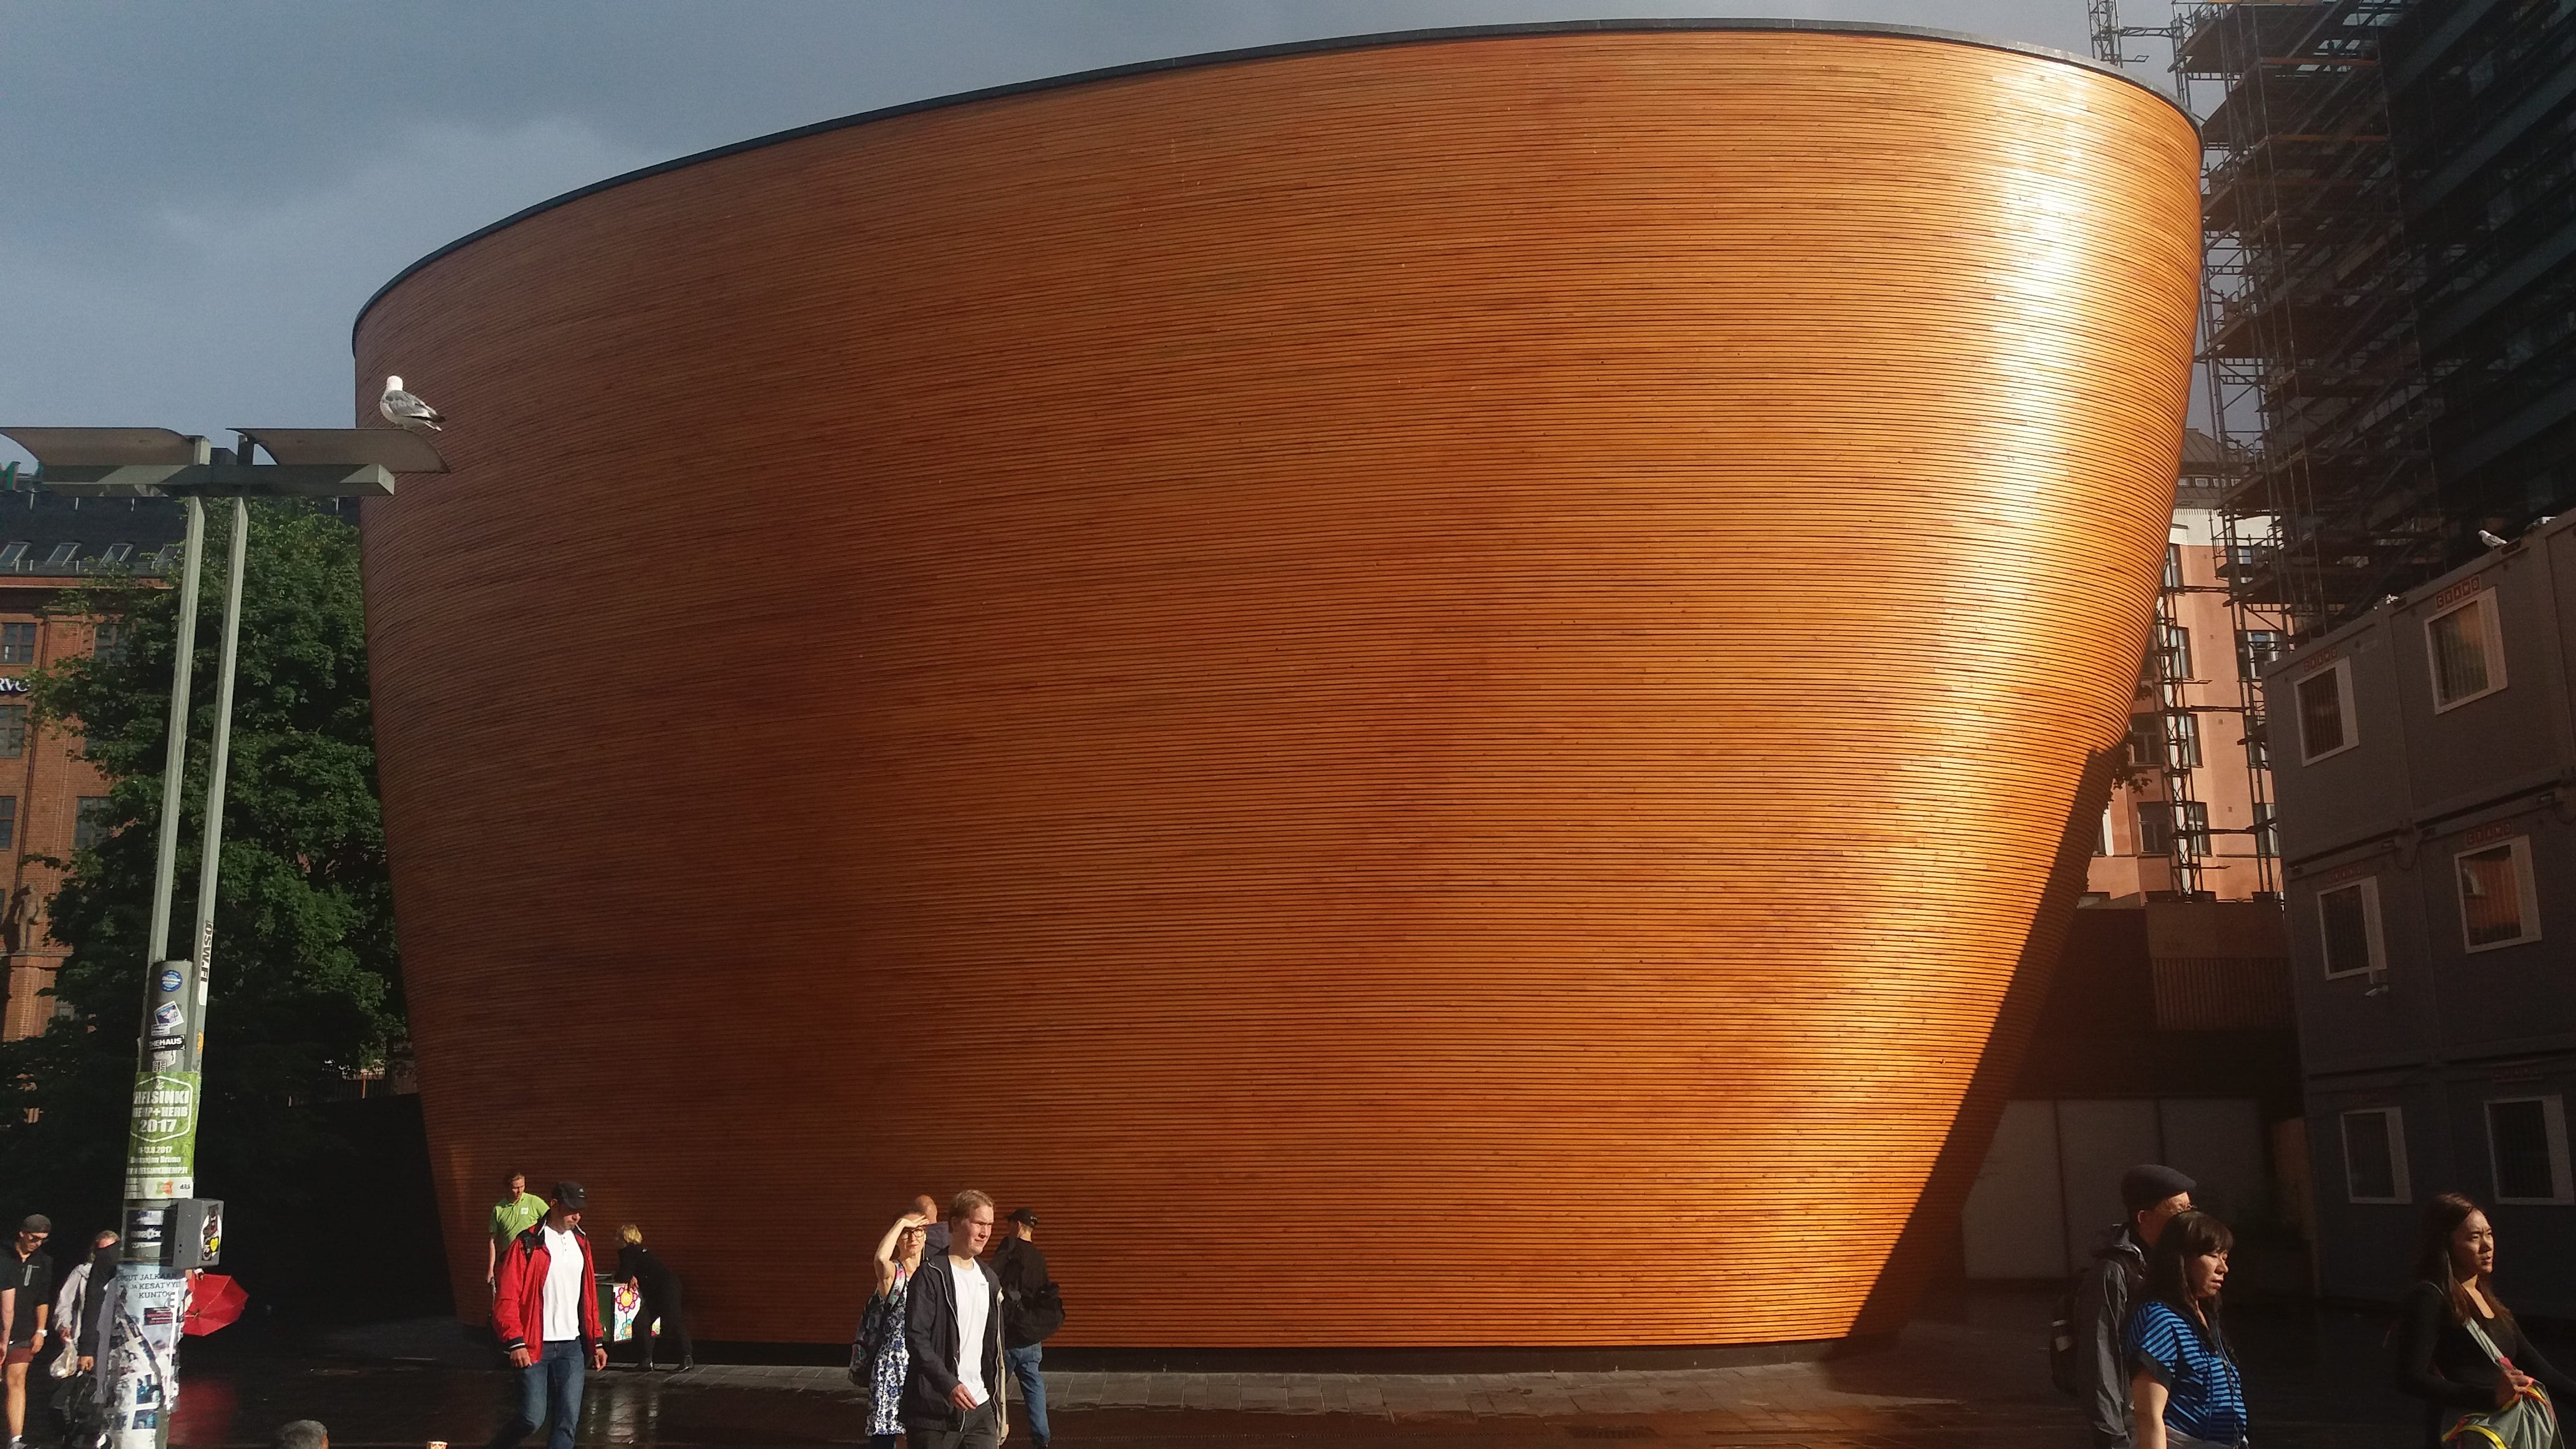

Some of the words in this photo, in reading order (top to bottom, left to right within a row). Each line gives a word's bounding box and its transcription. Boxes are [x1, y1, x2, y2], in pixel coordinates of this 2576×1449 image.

[2437, 578, 2478, 606] CRAMO
[134, 1090, 190, 1104] HELSINKI
[139, 1119, 177, 1133] 2017
